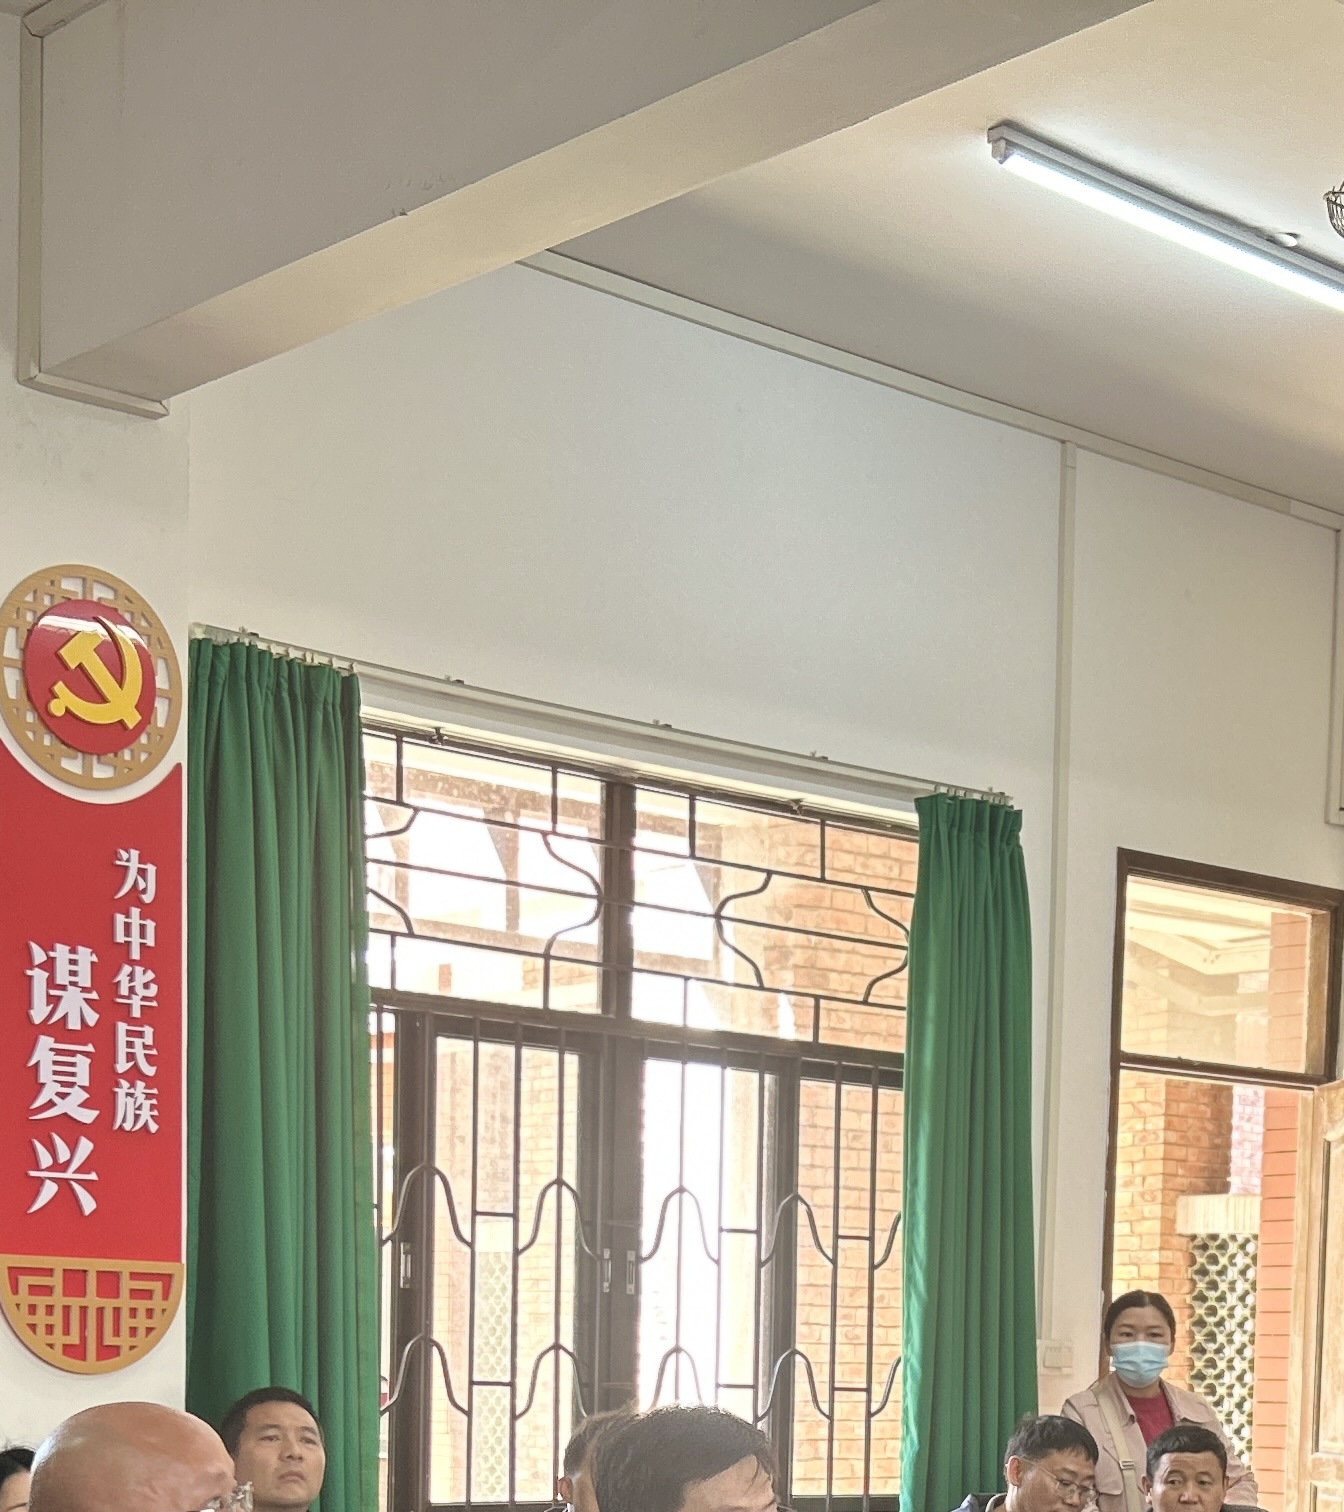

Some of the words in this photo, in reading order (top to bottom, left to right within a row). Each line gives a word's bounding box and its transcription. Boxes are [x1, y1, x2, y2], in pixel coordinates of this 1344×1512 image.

[24, 940, 101, 1217] 谋复兴
[112, 848, 160, 1135] 为中华民族
